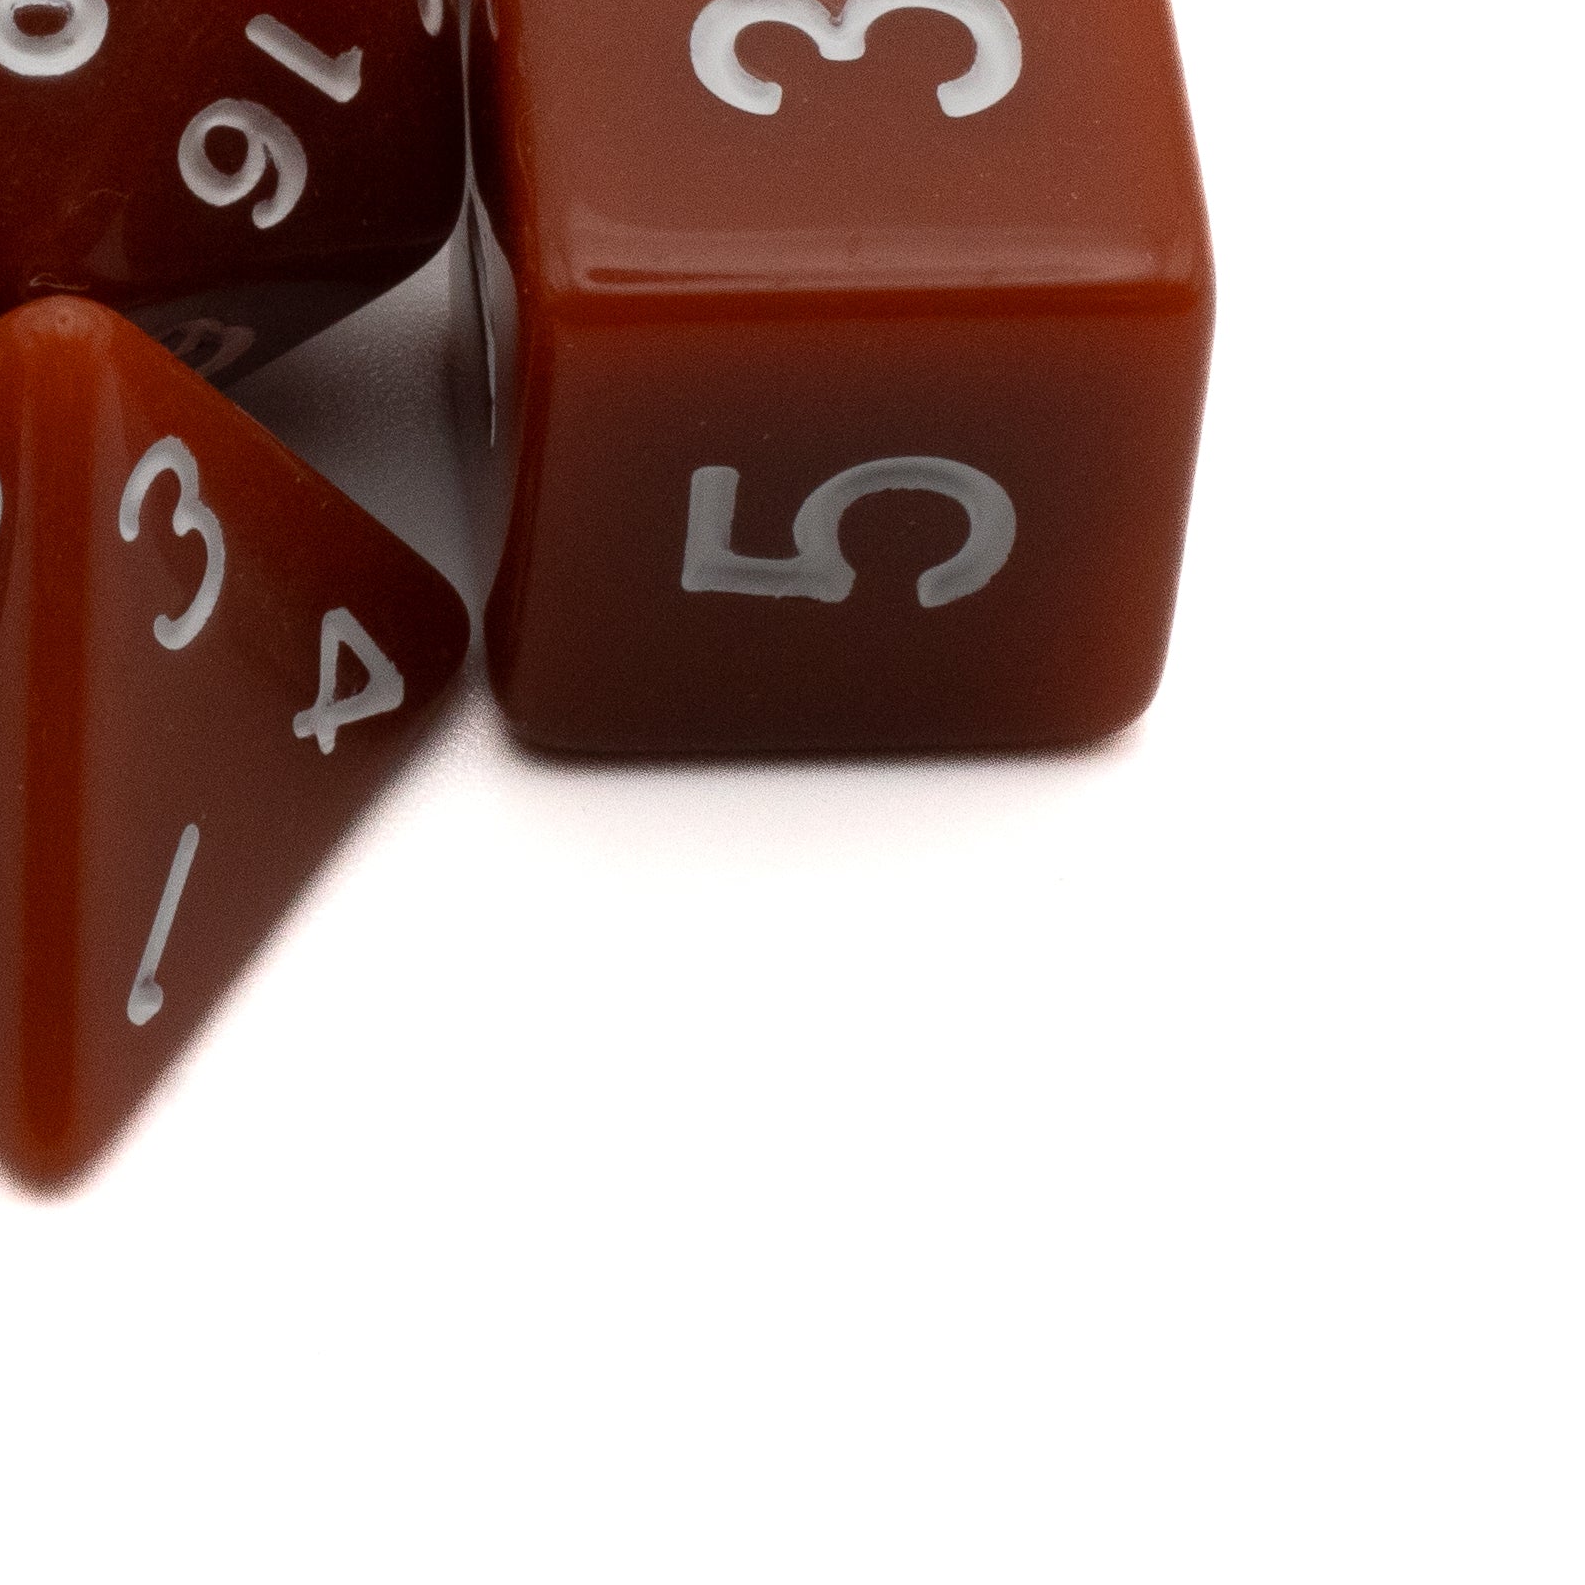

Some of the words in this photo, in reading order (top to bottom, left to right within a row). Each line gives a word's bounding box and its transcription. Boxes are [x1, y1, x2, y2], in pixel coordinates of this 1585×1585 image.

[177, 13, 364, 230] 16
[118, 435, 226, 651] 3
[680, 455, 1017, 608] 5
[292, 607, 405, 755] 4
[126, 823, 200, 1026] 1
